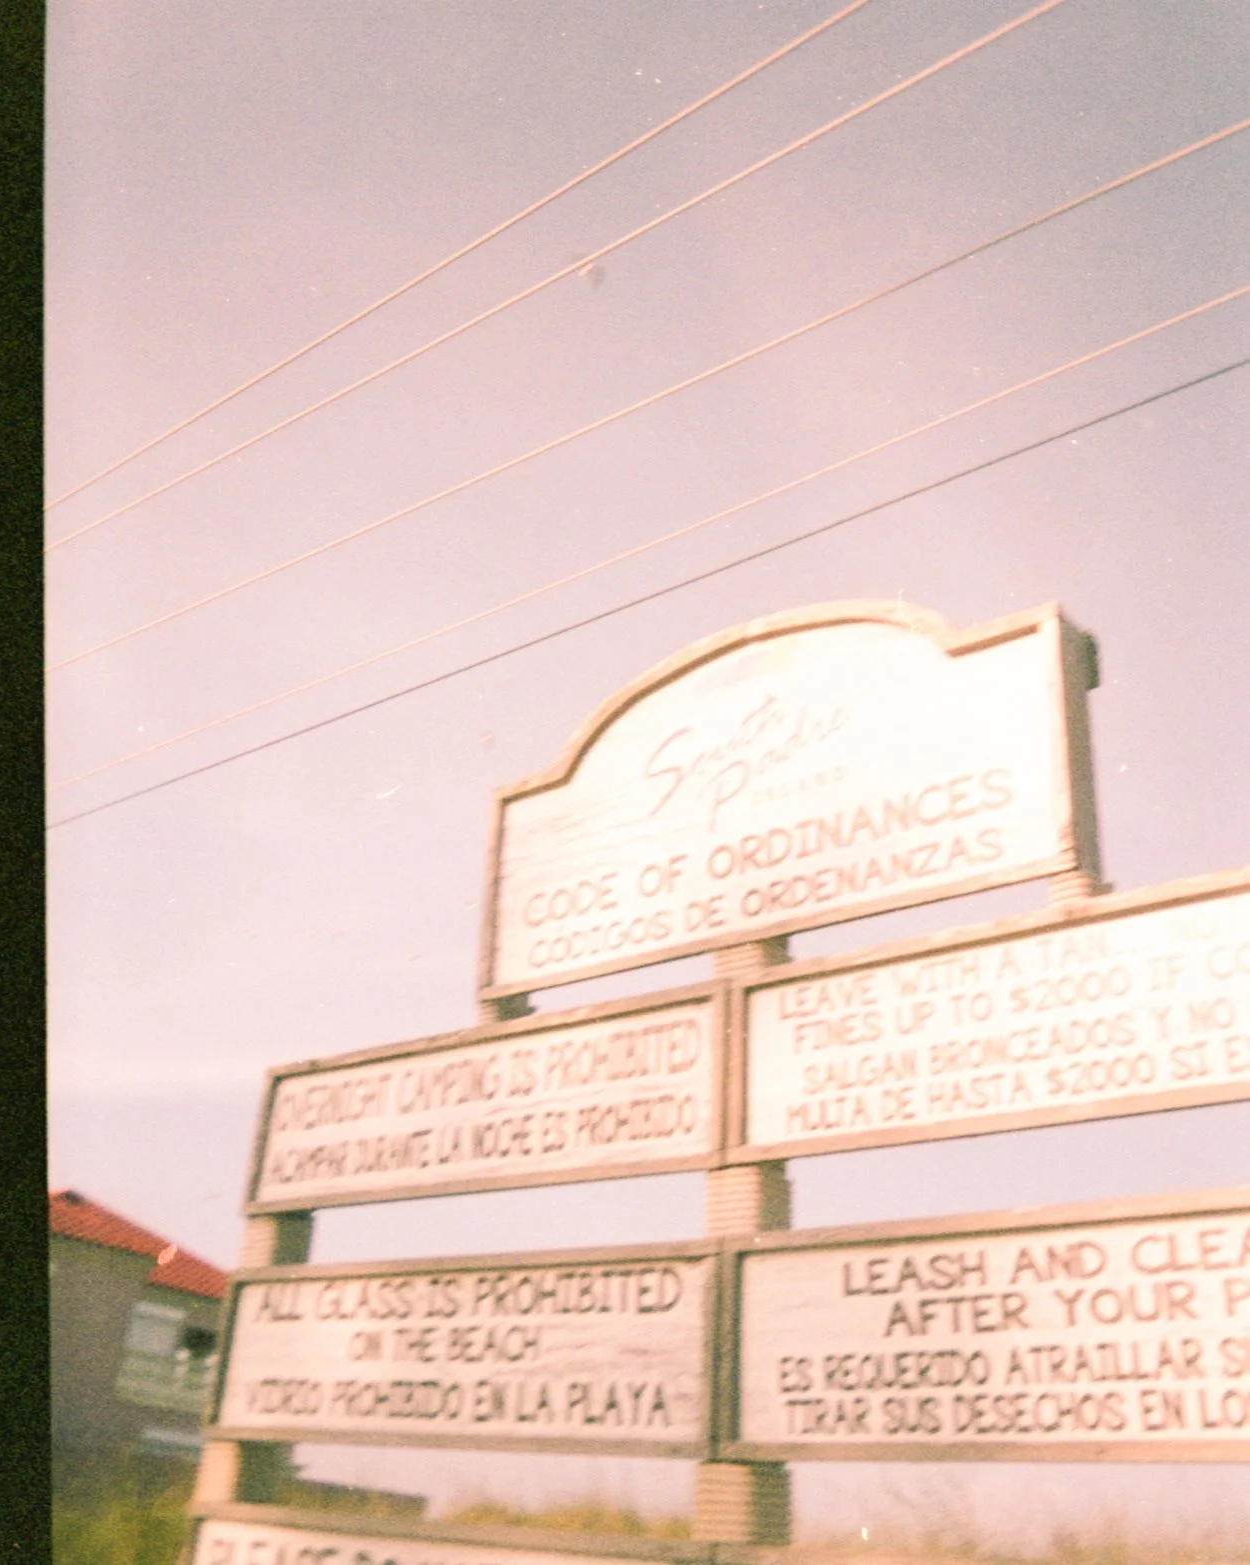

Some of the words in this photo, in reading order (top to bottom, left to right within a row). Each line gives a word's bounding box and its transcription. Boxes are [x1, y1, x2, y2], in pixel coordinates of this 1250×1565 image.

[523, 870, 619, 930] CODE
[637, 853, 689, 898] OF
[707, 767, 1014, 882] ORDINANCES
[685, 895, 728, 934] DE
[742, 827, 1004, 919] ORDENANZAS
[778, 974, 878, 1022] LEAVE
[894, 957, 984, 996] WITH
[997, 944, 1022, 981] A
[794, 1008, 883, 1054] FINES
[897, 1001, 936, 1037] UP
[952, 990, 995, 1027] TO
[1010, 966, 1134, 1014] $2000
[507, 1046, 538, 1099] IS
[548, 1016, 702, 1090] PROHIBITED
[803, 1043, 919, 1096] SALGAN
[929, 1015, 1137, 1078] BRONCEADOS
[1151, 1003, 1173, 1041] Y
[1188, 996, 1237, 1035] NO
[786, 1092, 874, 1137] MULTA
[881, 1084, 917, 1125] DE
[927, 1067, 1033, 1119] HASTA
[1046, 1050, 1157, 1098] $2000
[1169, 1039, 1213, 1082] SI
[254, 1284, 306, 1323] ALL
[317, 1279, 417, 1322] GLASS
[426, 1274, 463, 1319] IS
[472, 1266, 683, 1317] PROHIBITED
[842, 1248, 989, 1298] LEASH
[1009, 1239, 1109, 1286] AND
[882, 1290, 1032, 1339] AFTER
[1053, 1279, 1201, 1327] YOUR
[350, 1330, 382, 1364] ON
[395, 1327, 437, 1364] THE
[446, 1324, 543, 1364] BEACH
[779, 1352, 813, 1395] ES
[823, 1347, 993, 1393] REQUERIDO
[1004, 1335, 1207, 1387] ATRAILLAR
[473, 1379, 507, 1424] EN
[516, 1382, 553, 1425] LA
[566, 1380, 675, 1428] PLAYA
[784, 1396, 871, 1435] TIRAR
[881, 1394, 945, 1435] SUS
[953, 1388, 1128, 1435] DESECHOS
[1139, 1386, 1186, 1432] EN
